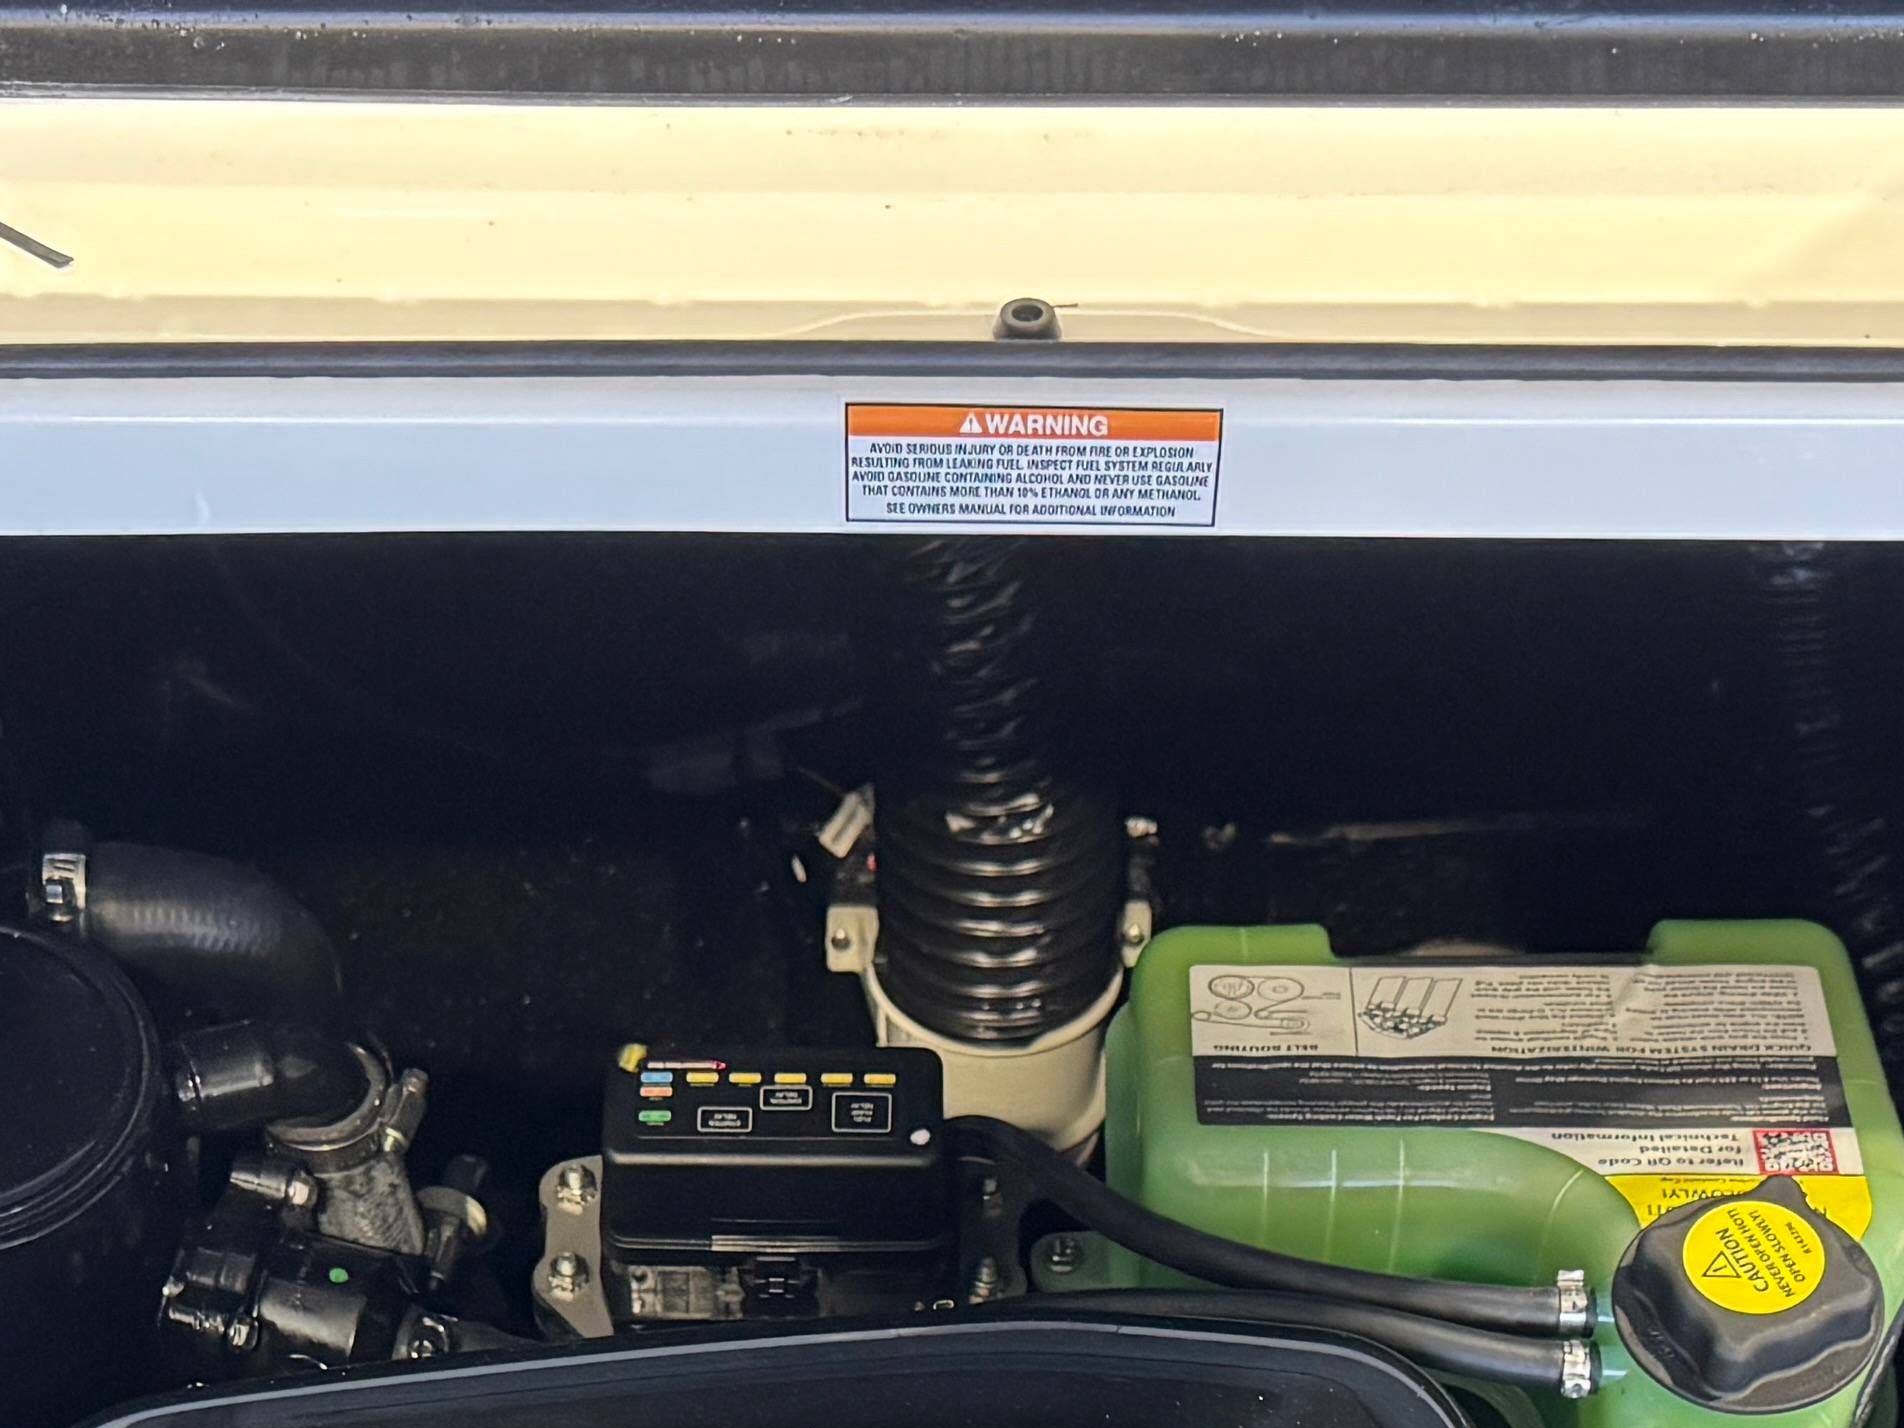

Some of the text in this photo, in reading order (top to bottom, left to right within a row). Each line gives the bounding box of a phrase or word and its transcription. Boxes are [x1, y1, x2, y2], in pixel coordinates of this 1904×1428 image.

[985, 413, 1109, 436] WARNING
[870, 443, 1194, 458] AVOID SERIOUS INJURY OR DEATH FROM FIRE OR EXPLOSION
[851, 457, 909, 468] RESULTING
[913, 458, 943, 469] FROM
[947, 458, 993, 469] LEAKING
[1027, 460, 1073, 471] INSPECT
[1076, 460, 1101, 471] FUEL
[1105, 461, 1148, 472] SYSTEM
[1152, 462, 1212, 473] REGULARLY
[852, 471, 1208, 487] AVOID GASOLINE CONTAINING ALCOHOL AND NEVER USE GASOLINE
[862, 485, 888, 496] THAT
[892, 486, 946, 497] CONTAINS
[950, 486, 981, 497] MORE
[984, 487, 1014, 497] THAN
[1041, 488, 1091, 499] ETHANOL
[1096, 488, 1109, 499] OR
[1112, 489, 1135, 500] ANY
[887, 503, 904, 513] SEE
[908, 503, 955, 514] OWNERS
[959, 504, 1006, 515] MANUAL
[1032, 505, 1097, 516] ADDITIONAL
[1101, 506, 1176, 517] INFORMATION
[1551, 1133, 1739, 1142] Technical Information
[1638, 1146, 1741, 1154] for Detailed
[1597, 1159, 1642, 1167] Code
[1676, 1158, 1694, 1166] to
[1699, 1158, 1744, 1167] Refer
[1746, 1234, 1771, 1263] OPEN
[1716, 1227, 1769, 1292] CAUTION
[1780, 1253, 1806, 1282] OPEN
[1764, 1261, 1795, 1297] NEVER
